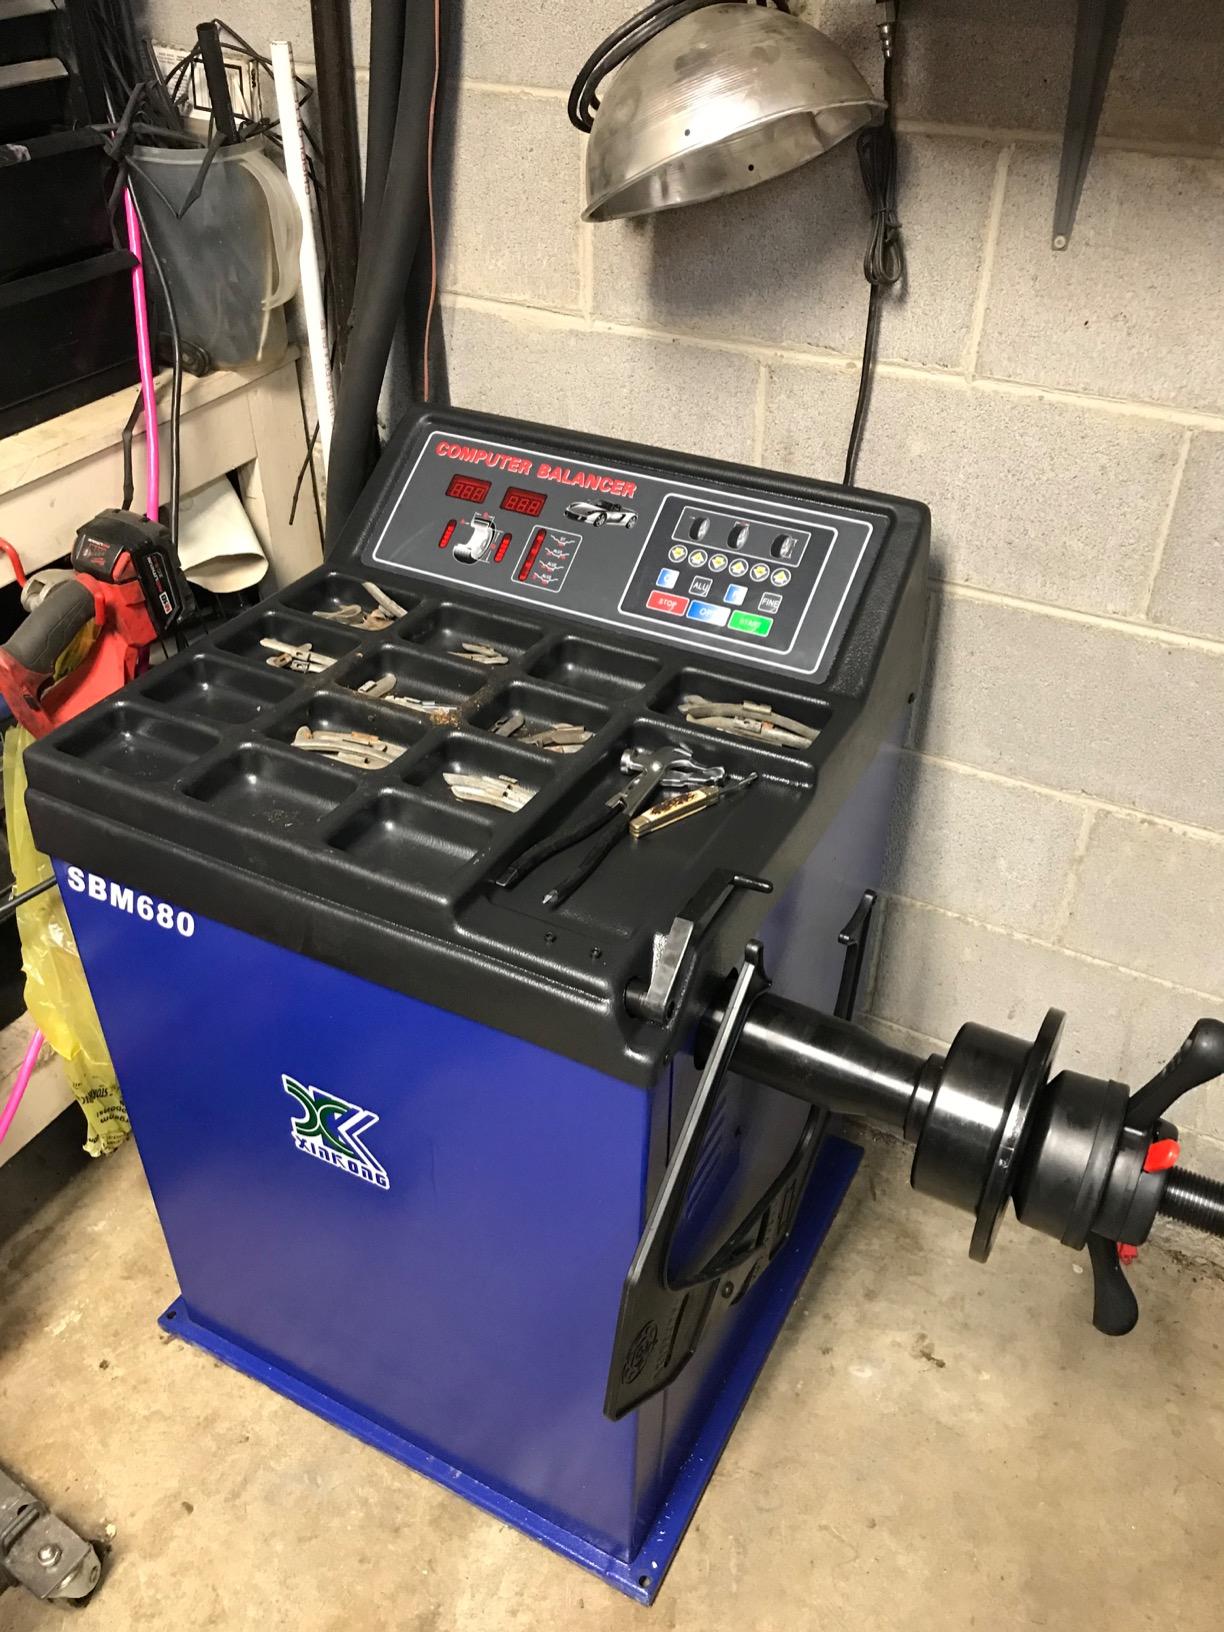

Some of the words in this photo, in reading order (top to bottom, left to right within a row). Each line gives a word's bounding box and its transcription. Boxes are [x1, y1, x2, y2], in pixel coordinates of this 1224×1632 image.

[435, 440, 533, 475] COMPUTER
[536, 463, 638, 498] BALANCER
[693, 581, 710, 592] ALU
[658, 597, 677, 608] STOP
[761, 596, 779, 608] FINE
[67, 865, 195, 938] SBM680
